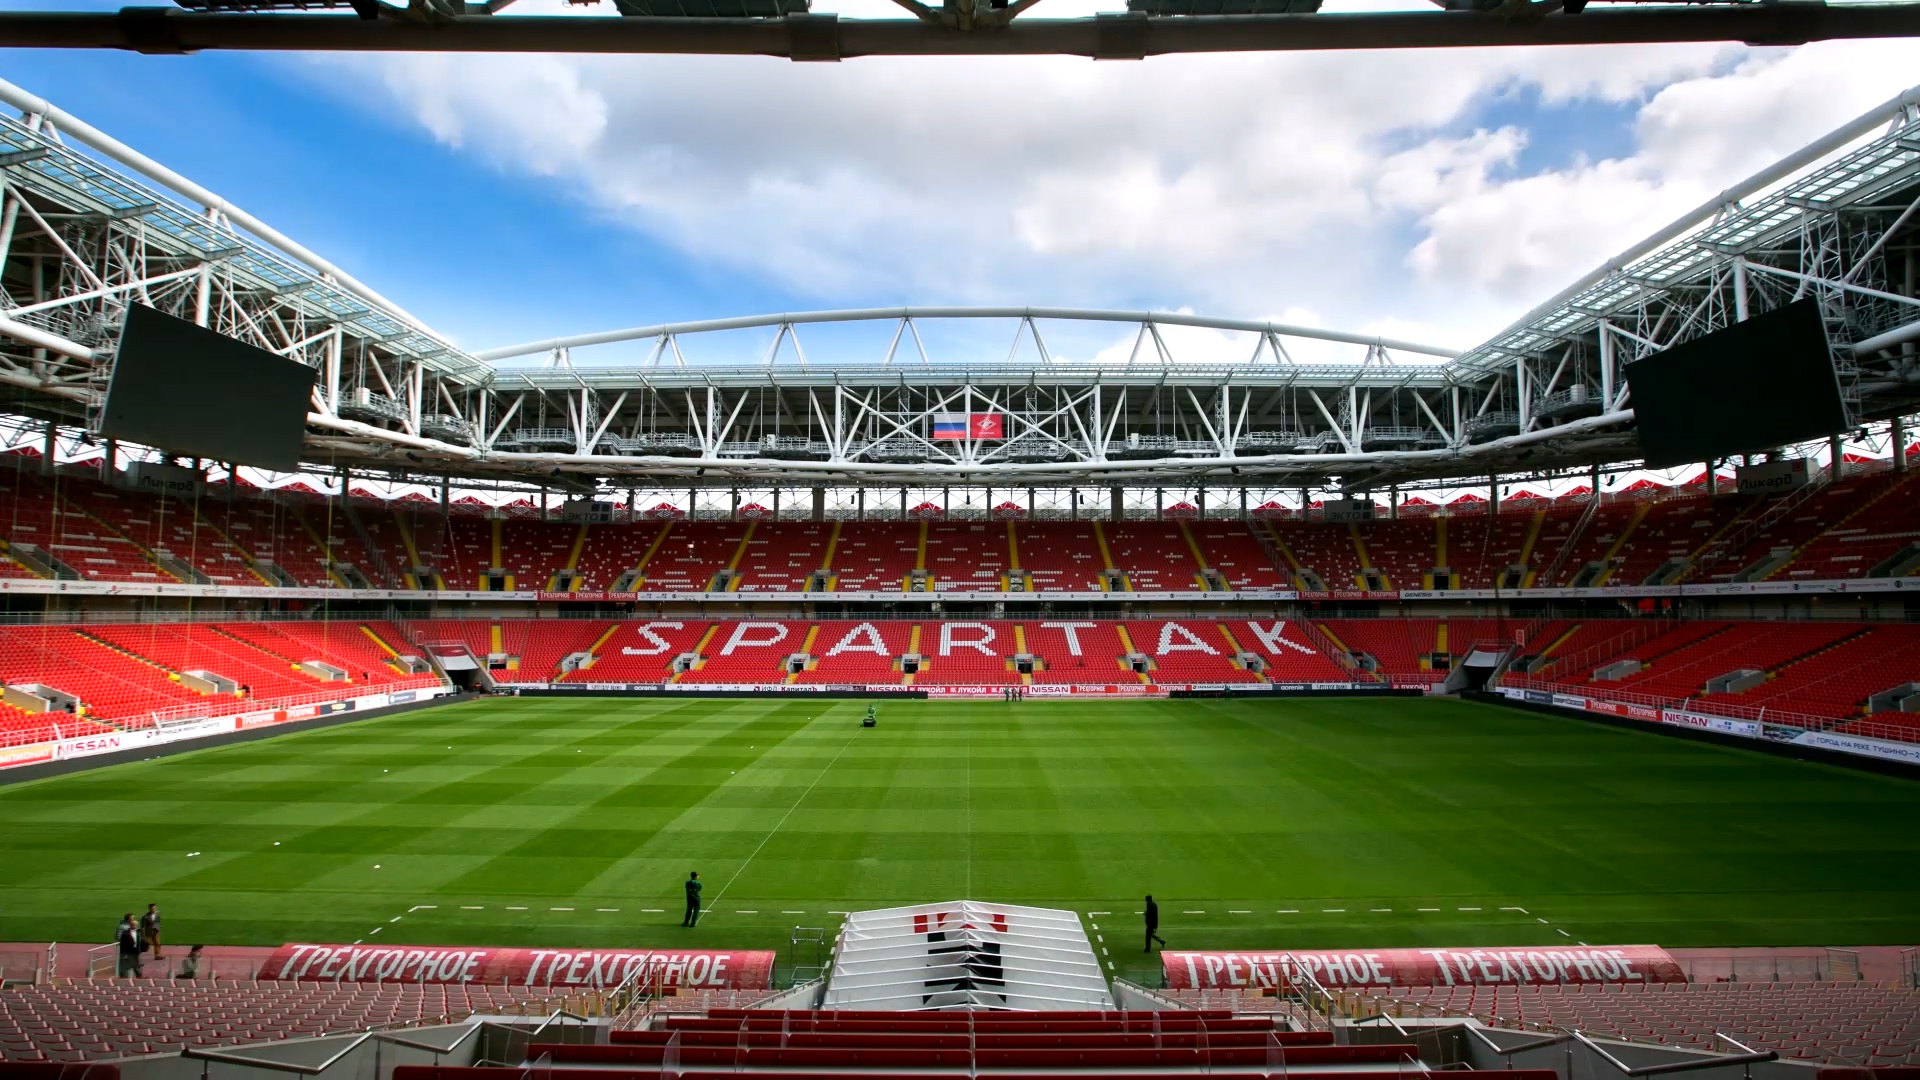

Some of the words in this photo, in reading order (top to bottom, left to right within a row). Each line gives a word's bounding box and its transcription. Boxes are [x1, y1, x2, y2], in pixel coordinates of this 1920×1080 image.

[622, 622, 1316, 656] SPARTAK
[917, 685, 946, 694] ЛУКОЙЛ
[957, 685, 987, 694] ЛУКОЙЛ
[1664, 712, 1708, 727] NISSAN
[57, 737, 121, 757] NISSAN
[1816, 736, 1840, 747] ГОРОД
